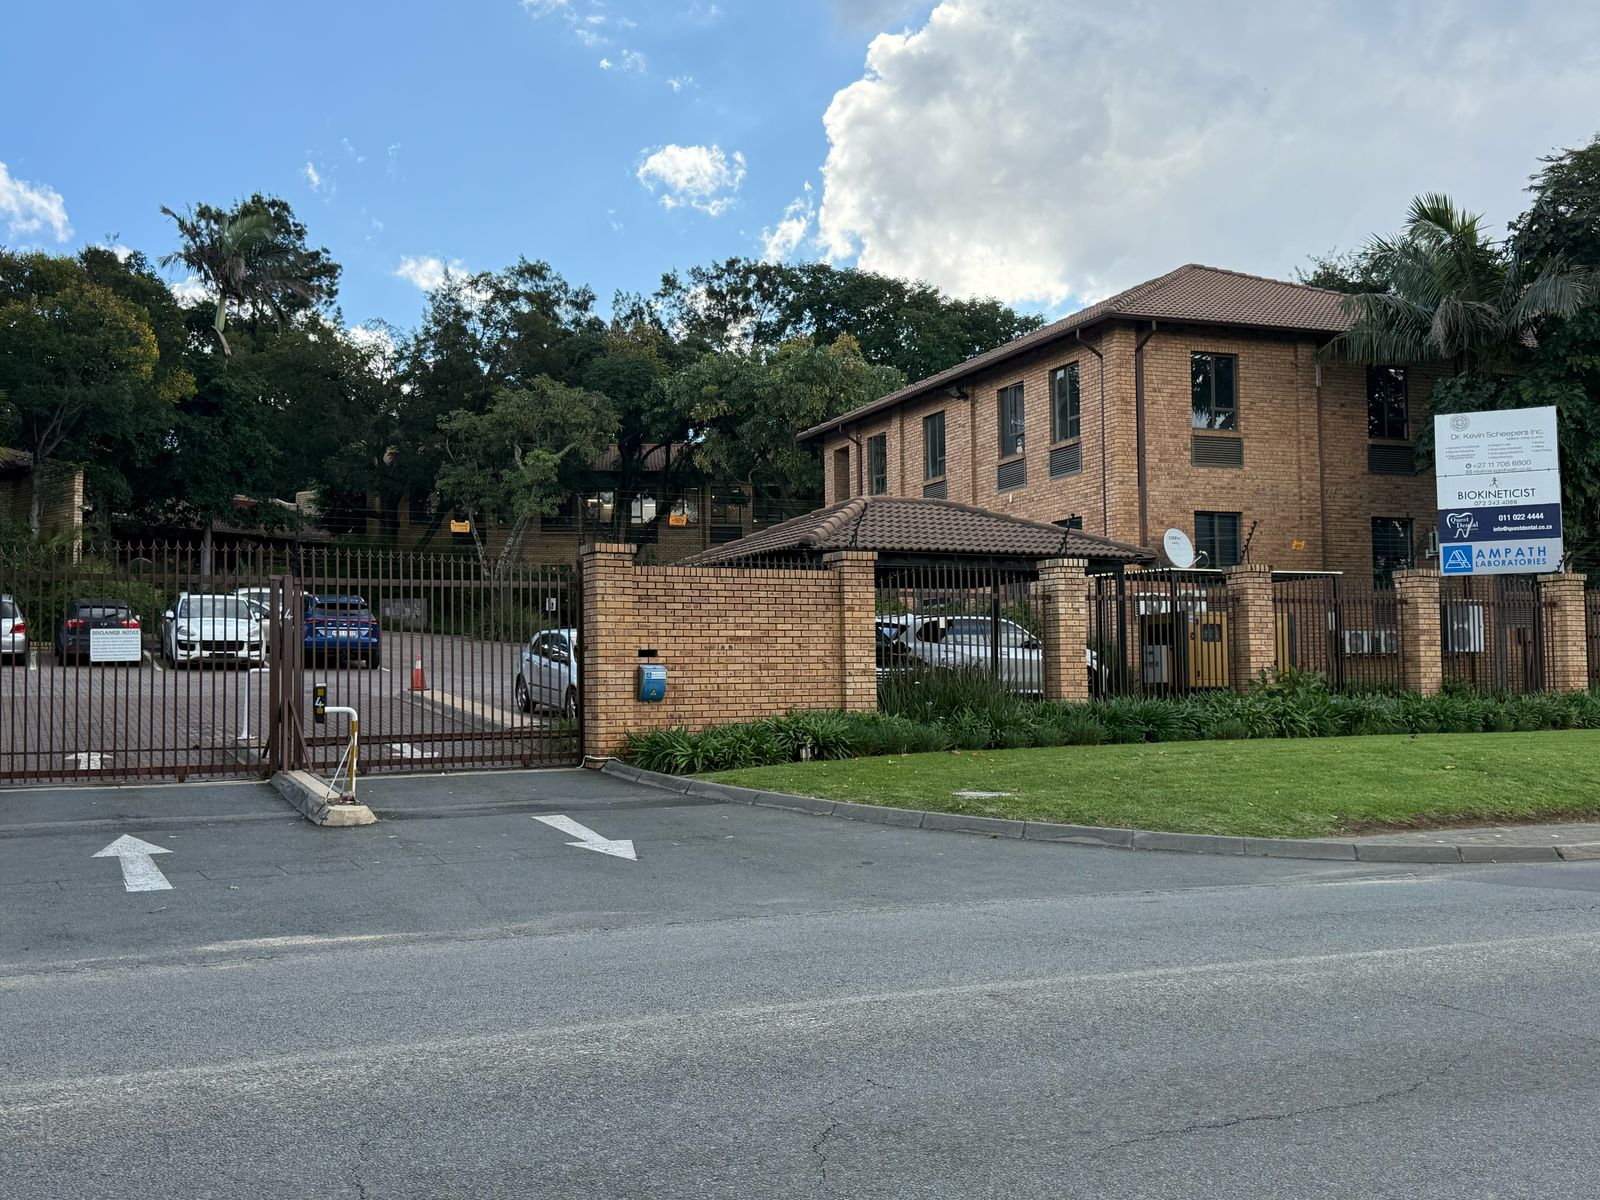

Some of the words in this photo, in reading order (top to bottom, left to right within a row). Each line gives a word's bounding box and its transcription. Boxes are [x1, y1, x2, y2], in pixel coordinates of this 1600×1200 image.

[1463, 431, 1485, 440] Kevin
[1486, 430, 1528, 438] Scheepers
[1457, 488, 1536, 500] BIOKINETICIST
[1526, 512, 1544, 520] 4444
[1475, 546, 1547, 559] AMPATH
[1475, 557, 1547, 568] LABORATORIES
[284, 608, 294, 621] 4
[314, 696, 325, 709] 4
